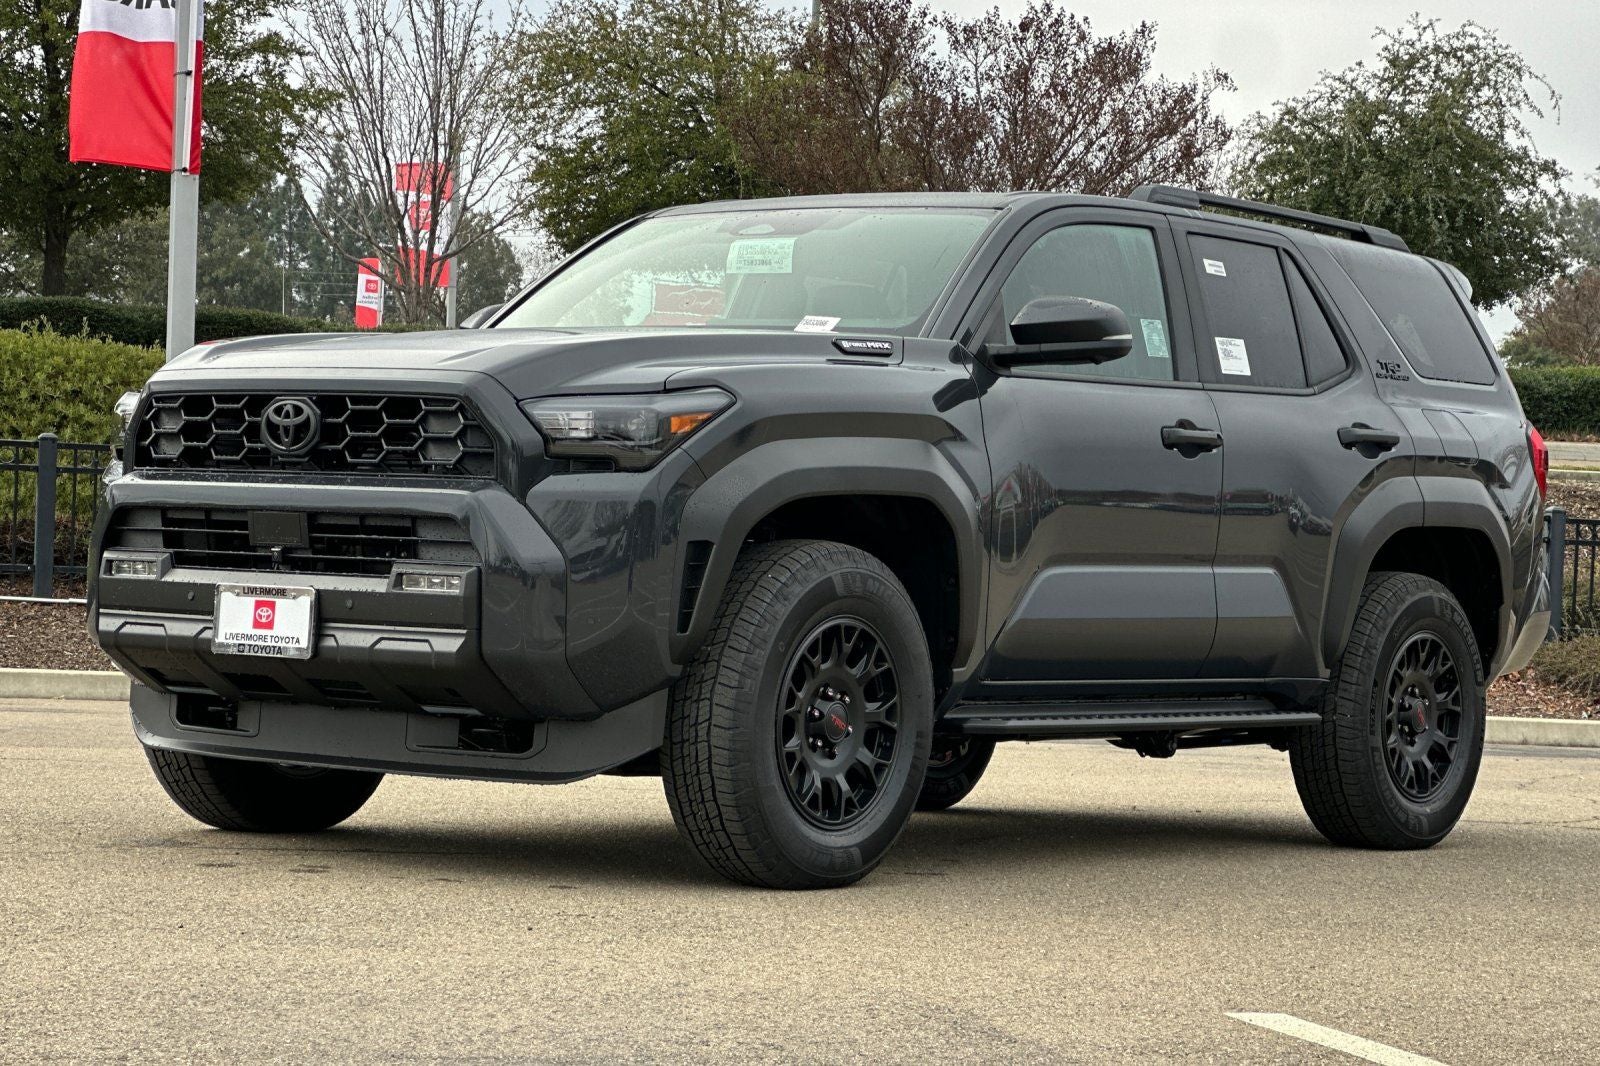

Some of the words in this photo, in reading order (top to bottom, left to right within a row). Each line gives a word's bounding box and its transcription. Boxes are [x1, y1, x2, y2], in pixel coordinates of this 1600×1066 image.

[866, 341, 892, 350] MAX
[242, 586, 288, 597] LIVERMORE
[224, 632, 269, 643] LIVERMORE
[270, 635, 300, 645] TOYOTA
[247, 643, 283, 656] TOYOTA
